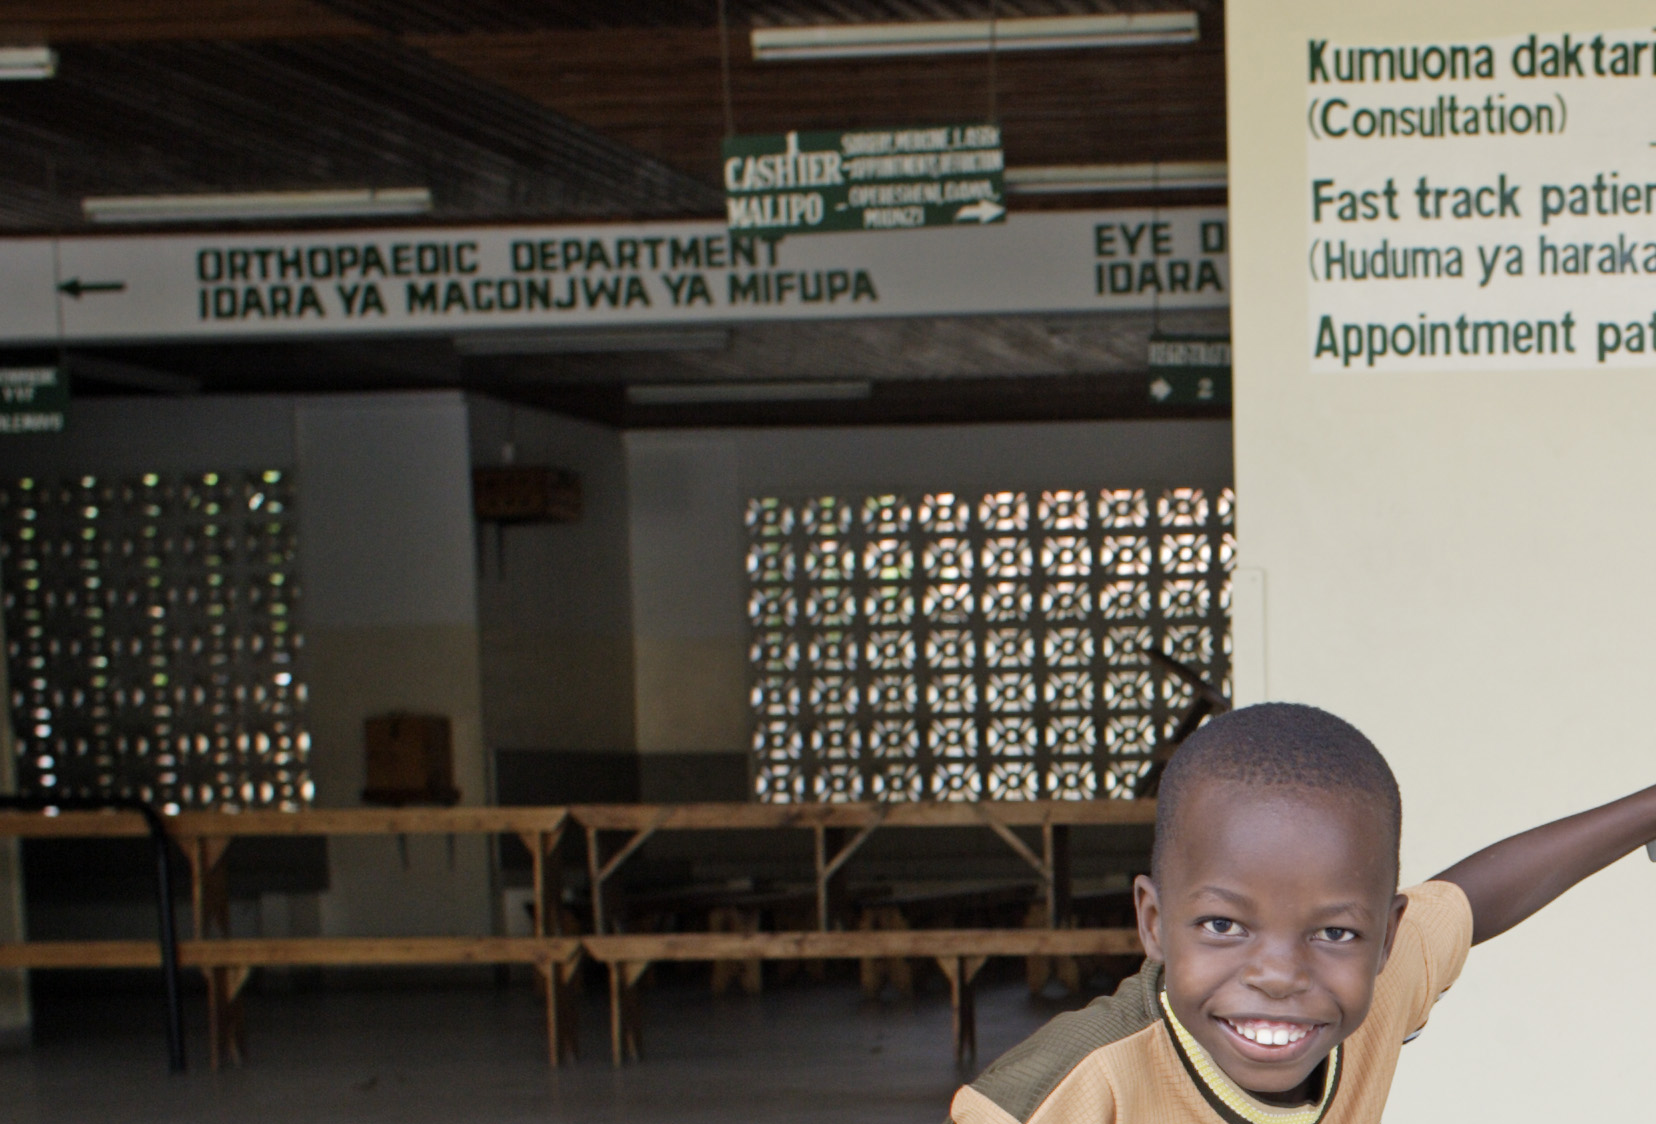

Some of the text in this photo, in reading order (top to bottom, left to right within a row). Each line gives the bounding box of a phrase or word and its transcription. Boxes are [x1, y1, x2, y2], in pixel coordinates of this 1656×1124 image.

[1309, 39, 1494, 82] Kumuona
[1309, 94, 1567, 138] (Consultation)
[724, 150, 844, 192] CASHIER
[726, 193, 824, 231] MALIPO
[1311, 179, 1398, 222] Fast
[1415, 174, 1520, 219] track
[197, 236, 783, 282] ORTHOPAEDIC DEPARTMENT
[1095, 222, 1172, 256] EYE
[1095, 260, 1223, 296] IDARA
[1309, 240, 1464, 282] (Huduma
[1477, 245, 1524, 287] ya
[199, 270, 877, 319] IDARA YA MAGONJWA YA MIFUPA
[1314, 313, 1576, 366] Appointment
